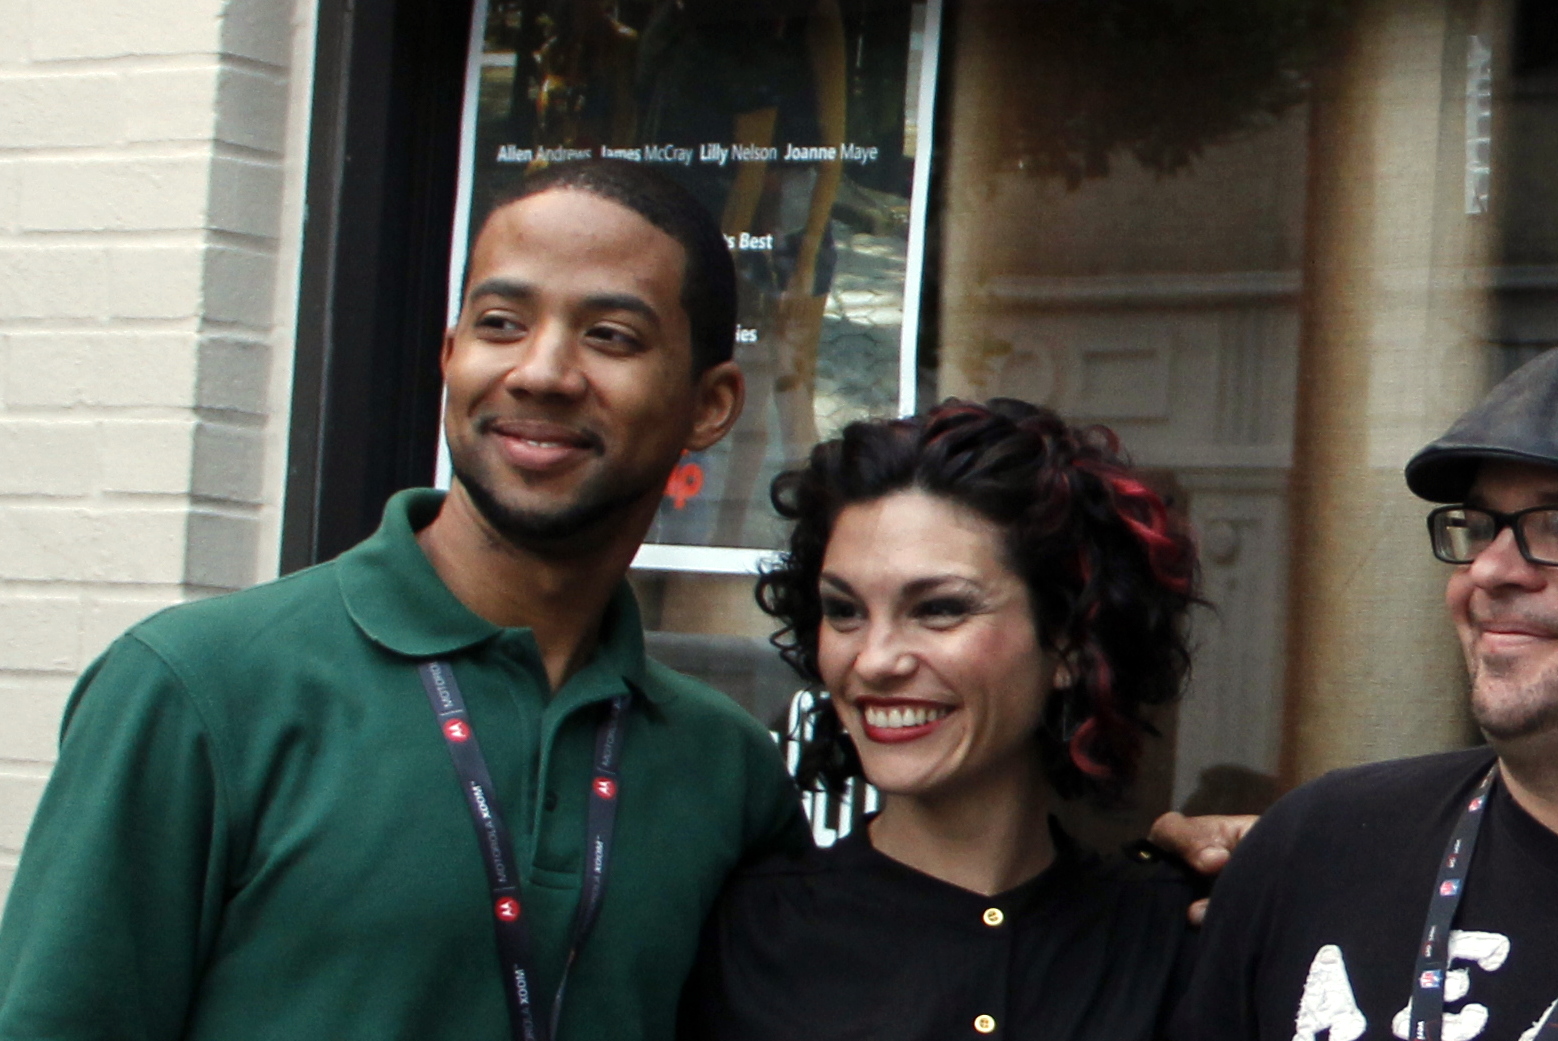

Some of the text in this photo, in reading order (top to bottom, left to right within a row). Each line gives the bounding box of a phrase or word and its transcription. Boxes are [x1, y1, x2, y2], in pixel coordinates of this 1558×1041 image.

[496, 144, 533, 162] Allen
[644, 144, 694, 166] McCray
[700, 143, 729, 166] Lilly
[731, 143, 777, 161] Nelson
[784, 143, 837, 161] Joanne
[839, 143, 878, 166] Maye
[739, 231, 774, 250] Best
[472, 783, 508, 883] MOTOROLA XOOM
[514, 968, 529, 1005] XOOM
